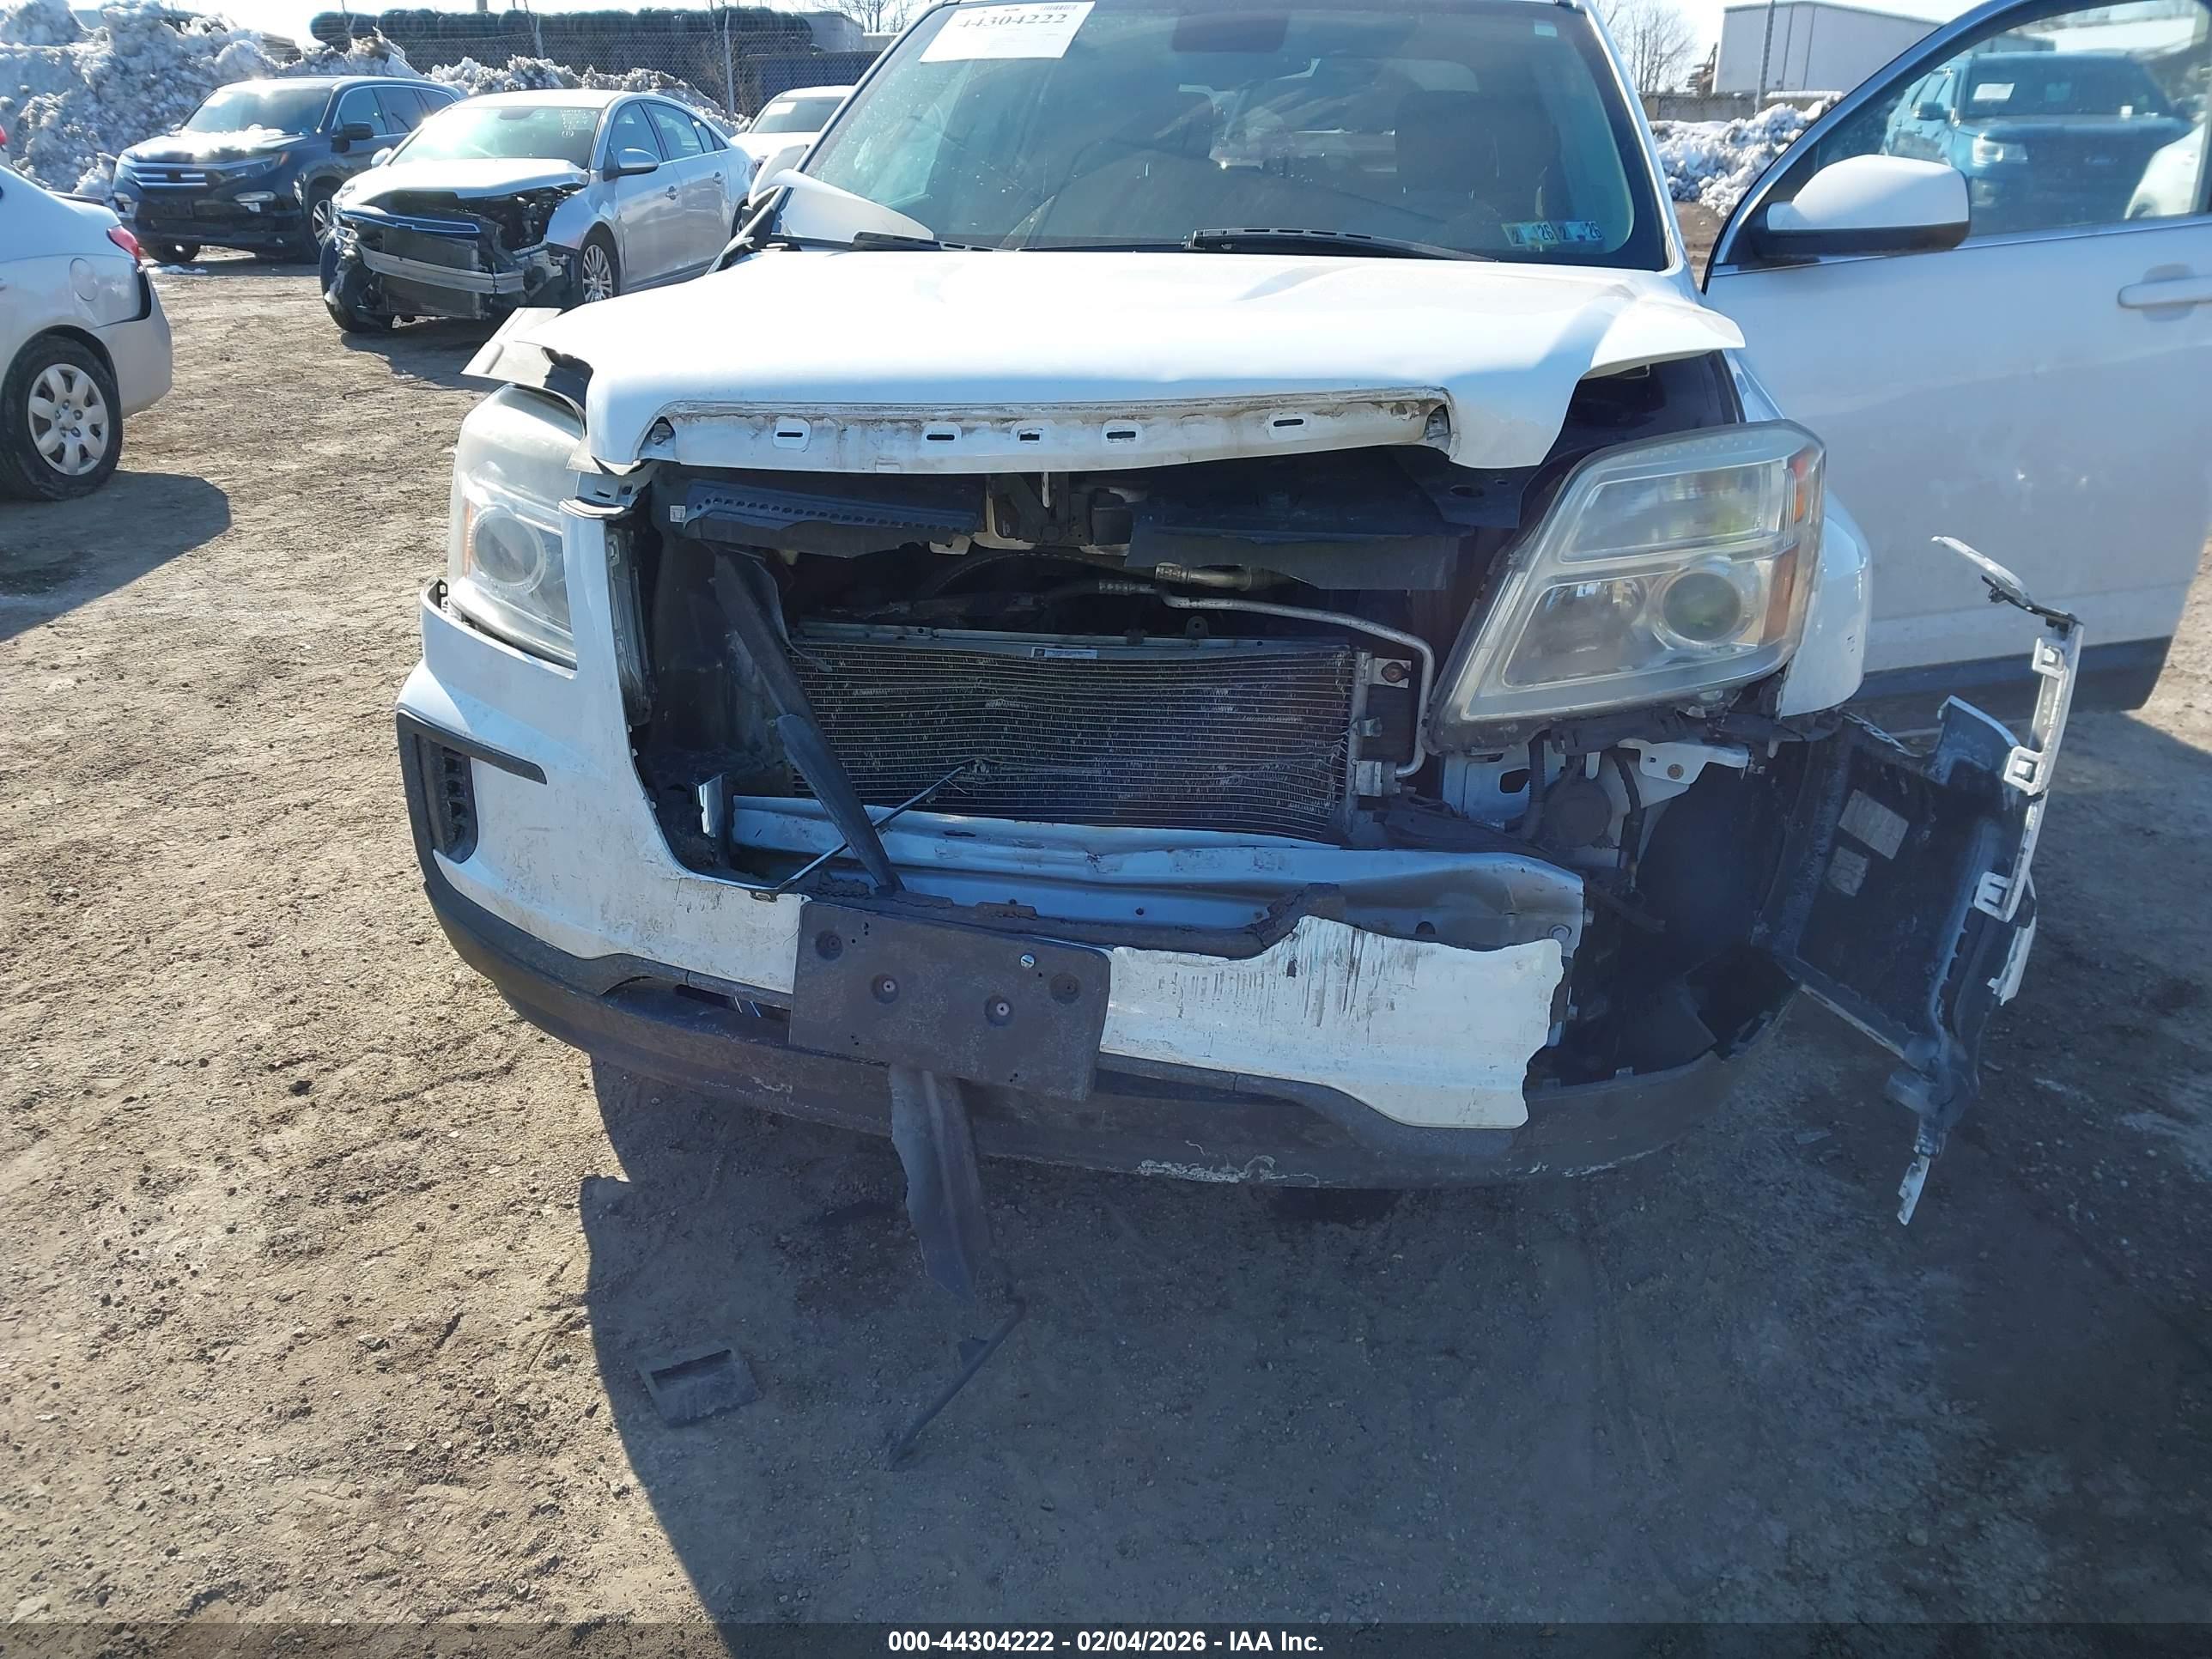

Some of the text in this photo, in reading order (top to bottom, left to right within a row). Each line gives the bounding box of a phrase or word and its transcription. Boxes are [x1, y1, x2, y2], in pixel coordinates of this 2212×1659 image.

[958, 14, 1068, 27] 44304222
[1537, 224, 1555, 241] 26
[1585, 222, 1602, 239] 26
